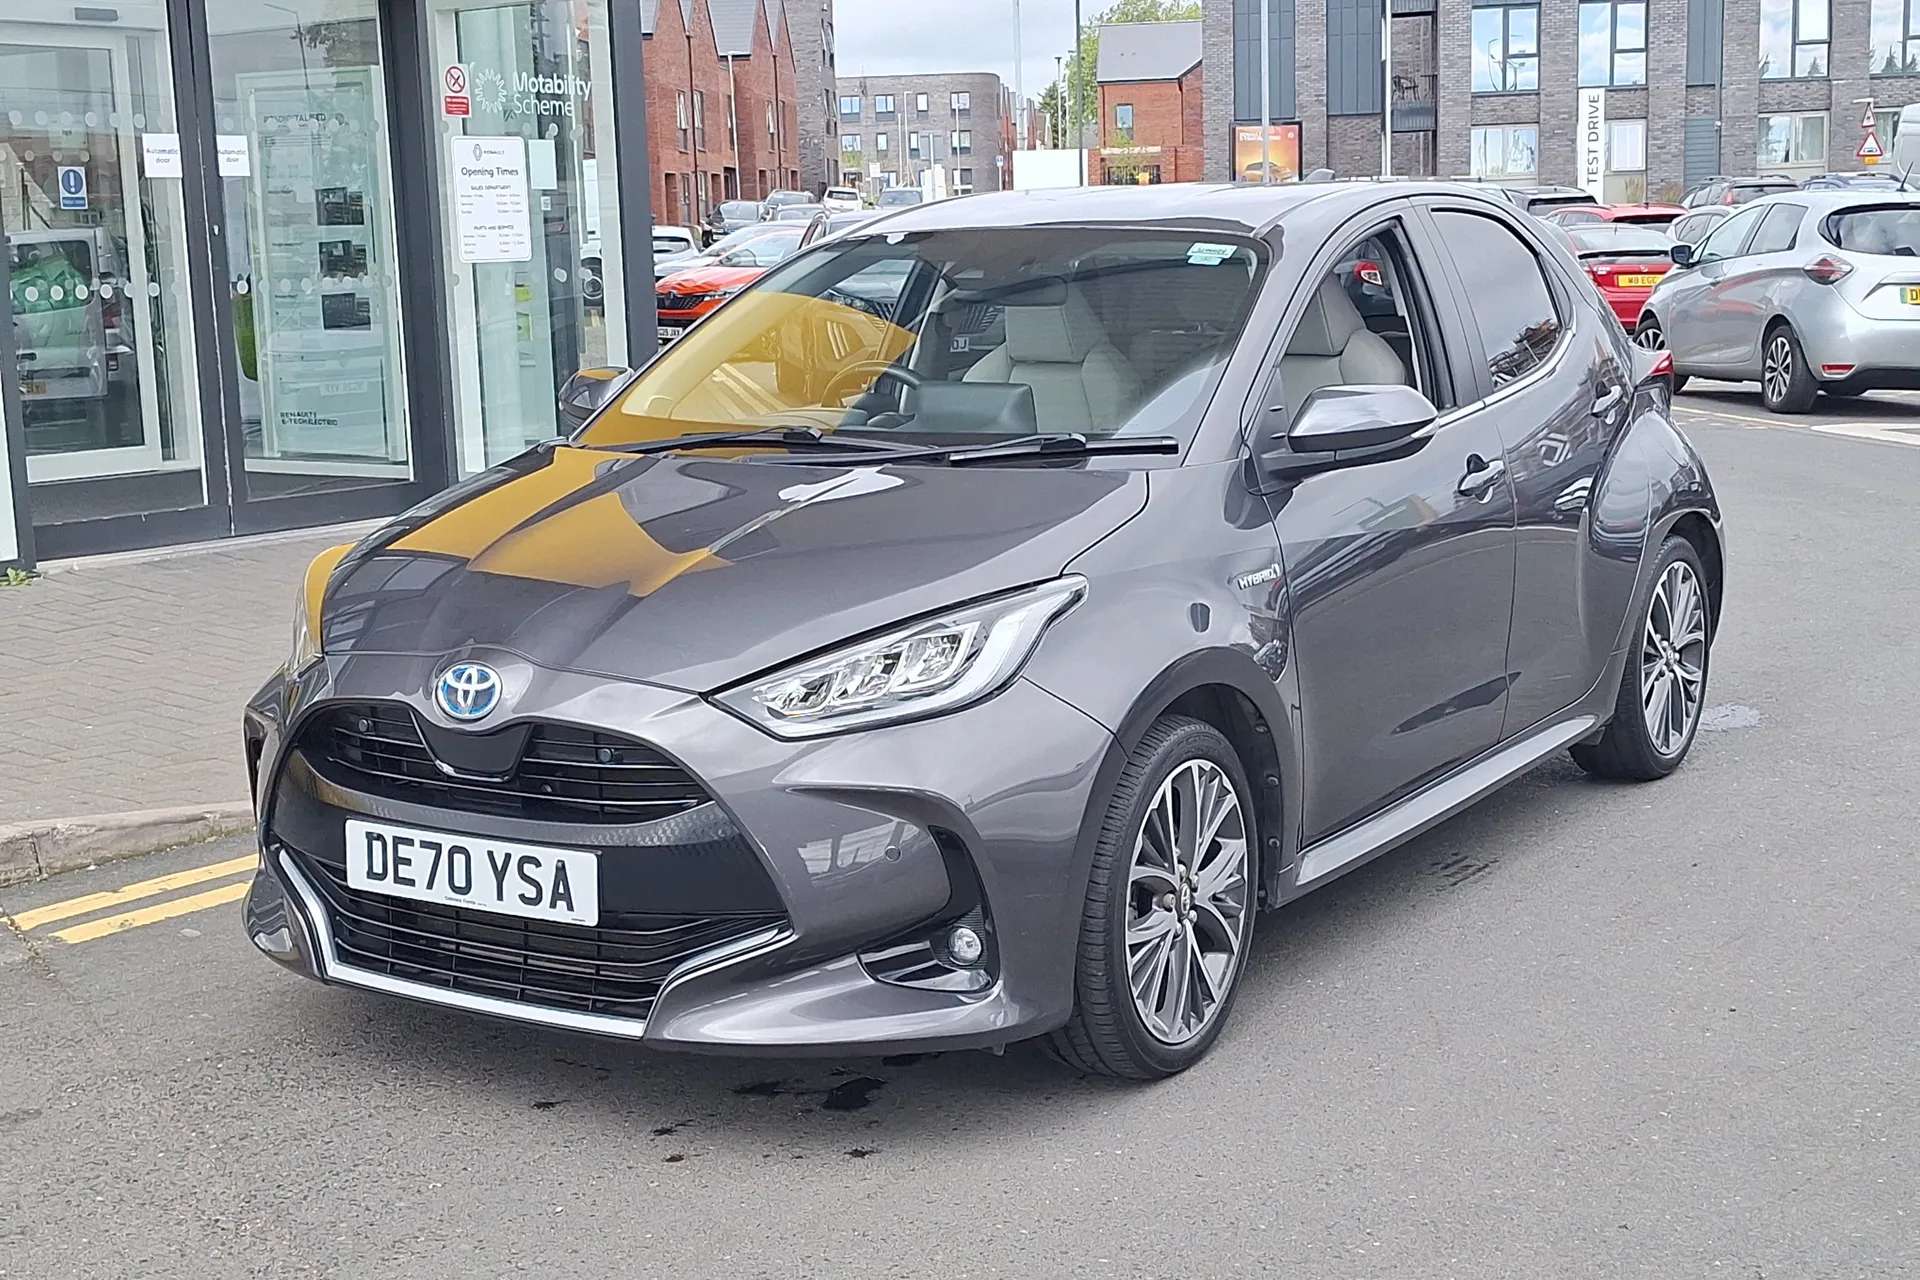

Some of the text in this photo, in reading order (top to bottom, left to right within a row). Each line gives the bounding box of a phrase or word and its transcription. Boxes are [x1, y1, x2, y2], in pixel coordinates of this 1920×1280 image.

[512, 71, 592, 101] Motability
[513, 94, 573, 117] Scheme
[1587, 94, 1600, 186] TEST DRIVE
[461, 166, 519, 178] Opening Times
[365, 831, 575, 913] DE70 YSA
